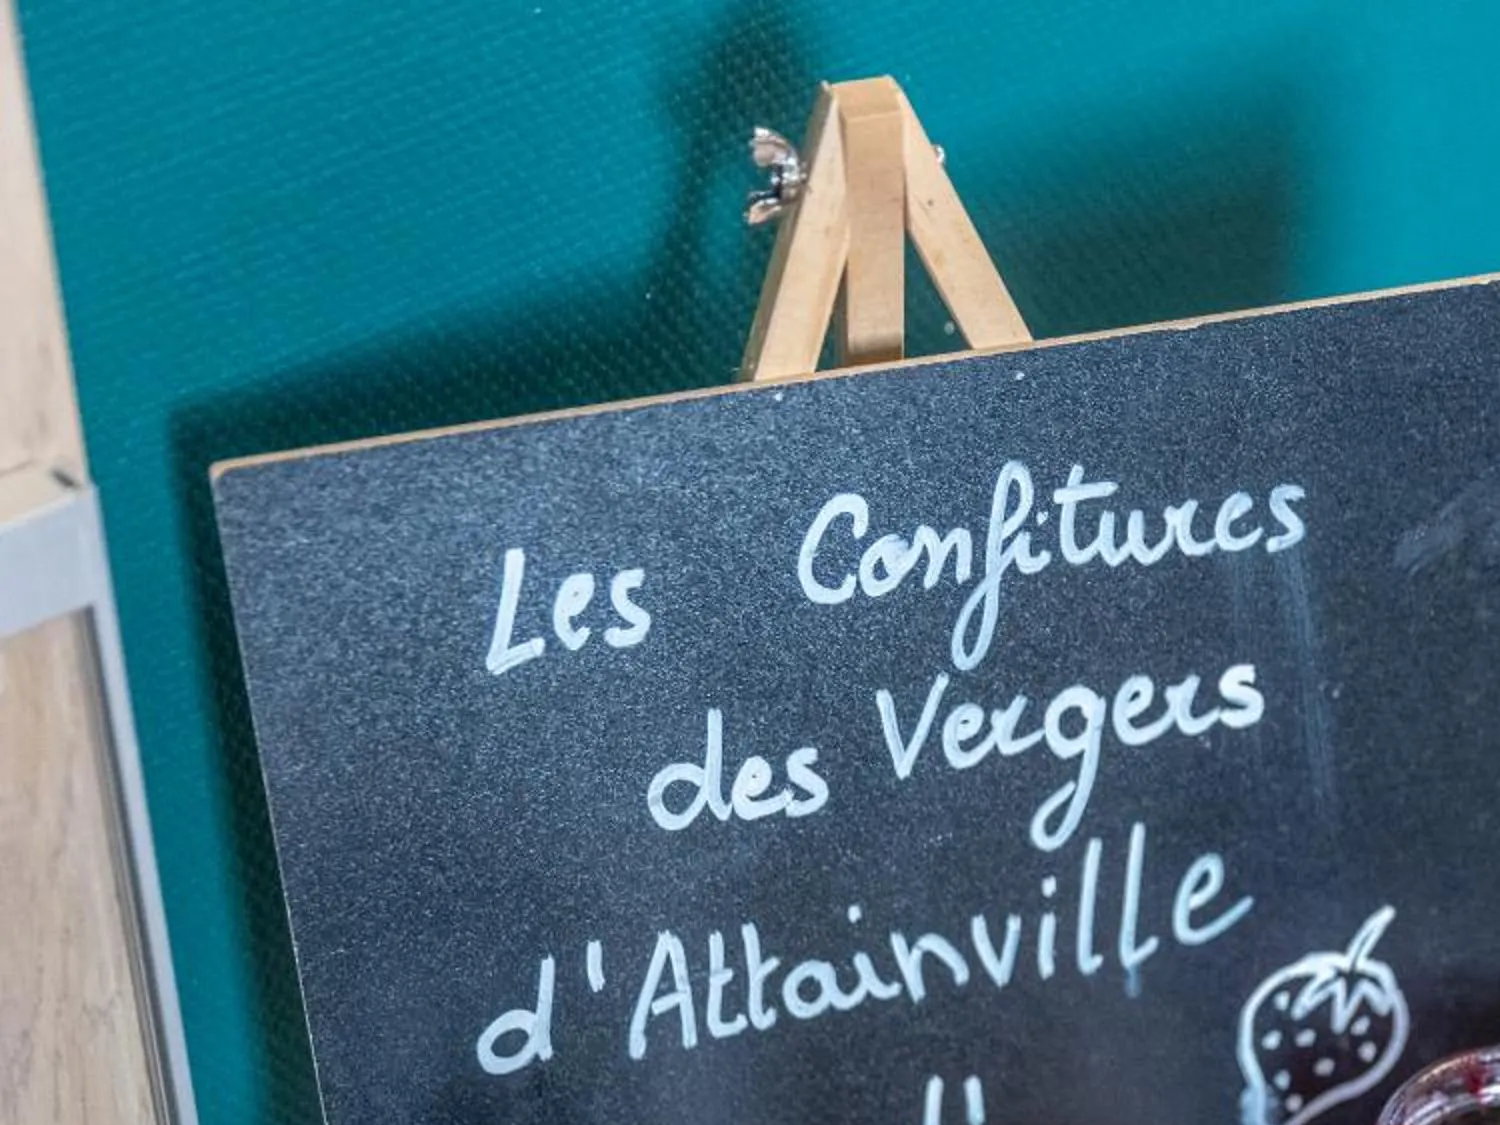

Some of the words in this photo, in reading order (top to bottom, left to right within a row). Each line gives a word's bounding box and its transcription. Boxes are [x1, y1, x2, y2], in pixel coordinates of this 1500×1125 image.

[484, 547, 652, 675] Les
[798, 459, 1306, 672] Confitures
[647, 707, 830, 831] des
[876, 662, 1266, 851] Vergers
[476, 820, 1252, 1074] d'Attainville
